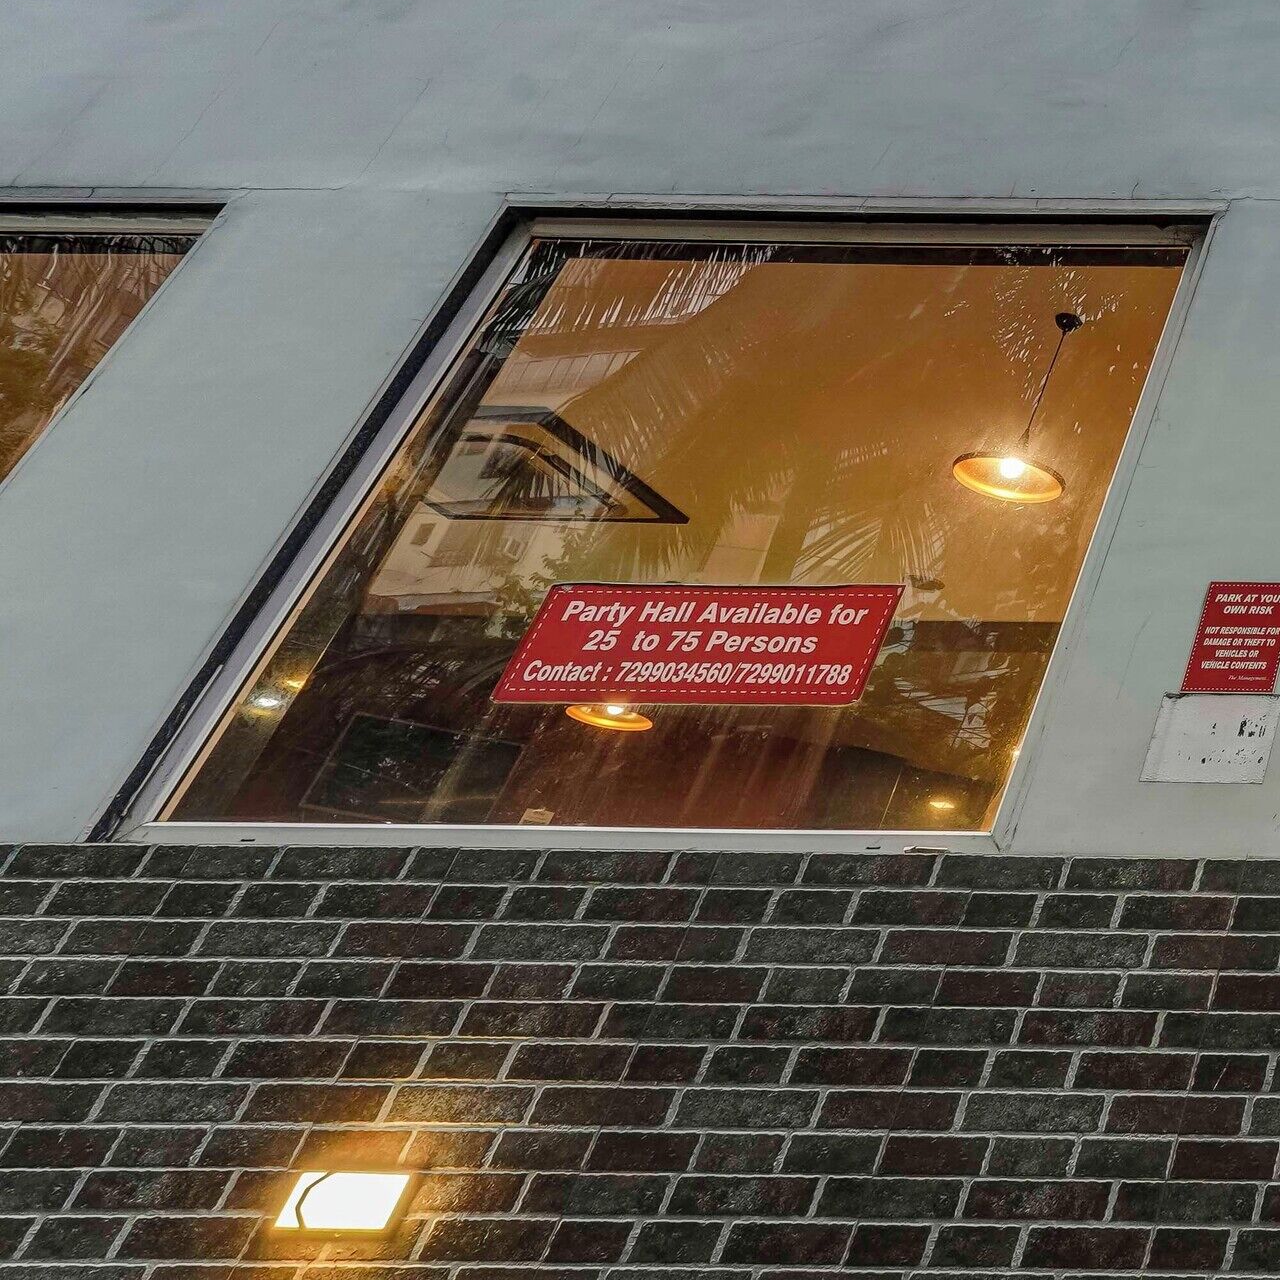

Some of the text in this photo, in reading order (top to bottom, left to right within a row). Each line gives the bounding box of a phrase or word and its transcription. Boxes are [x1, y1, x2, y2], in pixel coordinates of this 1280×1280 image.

[1215, 593, 1243, 603] PARK
[1243, 593, 1259, 603] AT
[560, 599, 870, 628] Party Hall Available for
[1223, 605, 1274, 615] OWN RISK
[1204, 626, 1280, 635] NOT RESPONSIBLE FOR
[582, 630, 818, 654] 25 to 75 Persons
[1203, 638, 1276, 647] DAMAGE OR THEFT TO
[1215, 649, 1260, 658] VEHICLES OR
[1201, 660, 1268, 670] VEHICLE CONTENTS
[522, 660, 600, 682] Contact
[614, 660, 852, 687] 7299034560/7299011788
